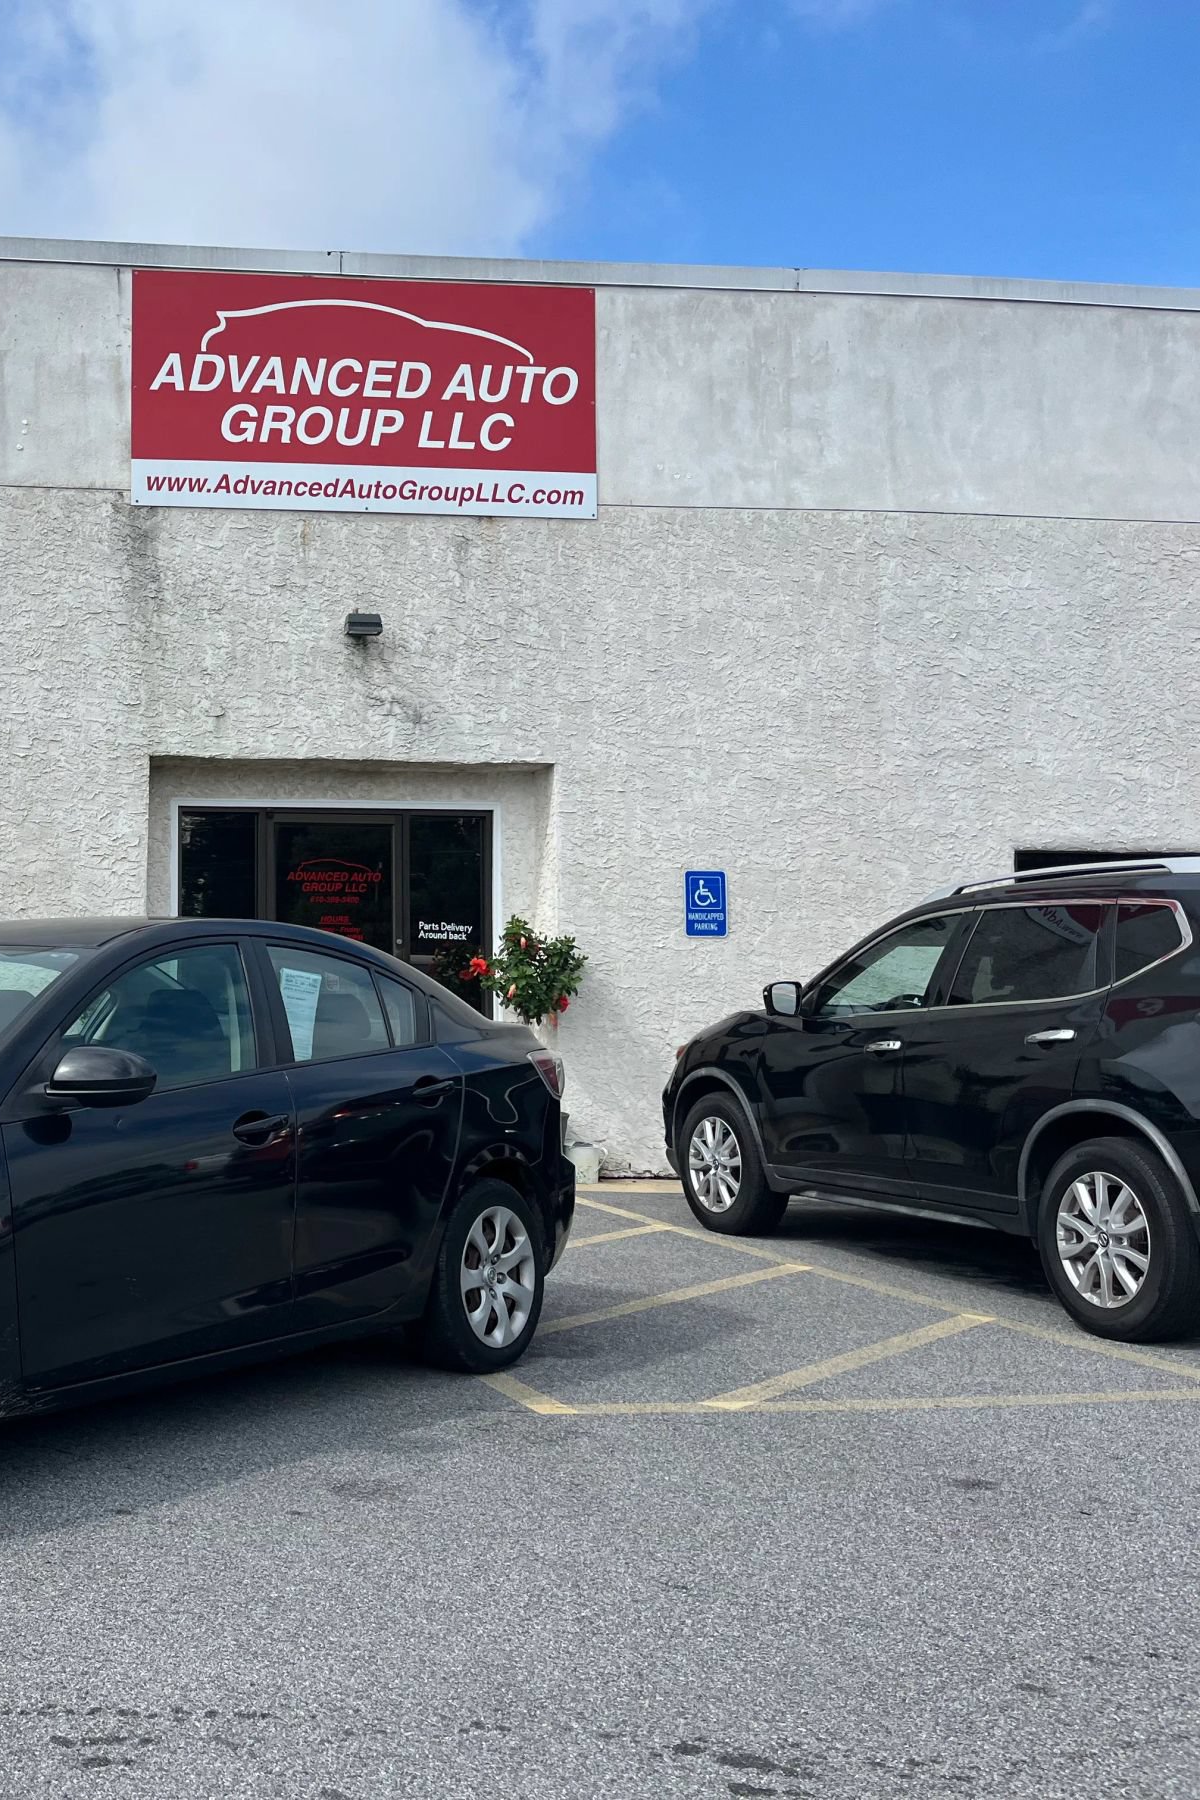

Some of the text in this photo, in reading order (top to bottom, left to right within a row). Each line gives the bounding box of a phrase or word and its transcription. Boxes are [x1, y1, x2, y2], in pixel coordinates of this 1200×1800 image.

[149, 352, 579, 406] ADVANCED AUTO
[220, 403, 515, 452] GROUP LLC
[145, 473, 585, 507] www.AdvancedAutoGroupLLC.com
[287, 871, 382, 882] ADVANCED AUTO
[302, 882, 368, 893] GROUP LLC
[688, 912, 724, 920] HANDICAPPED
[418, 921, 473, 934] Parts Delivery
[418, 930, 467, 941] Around back
